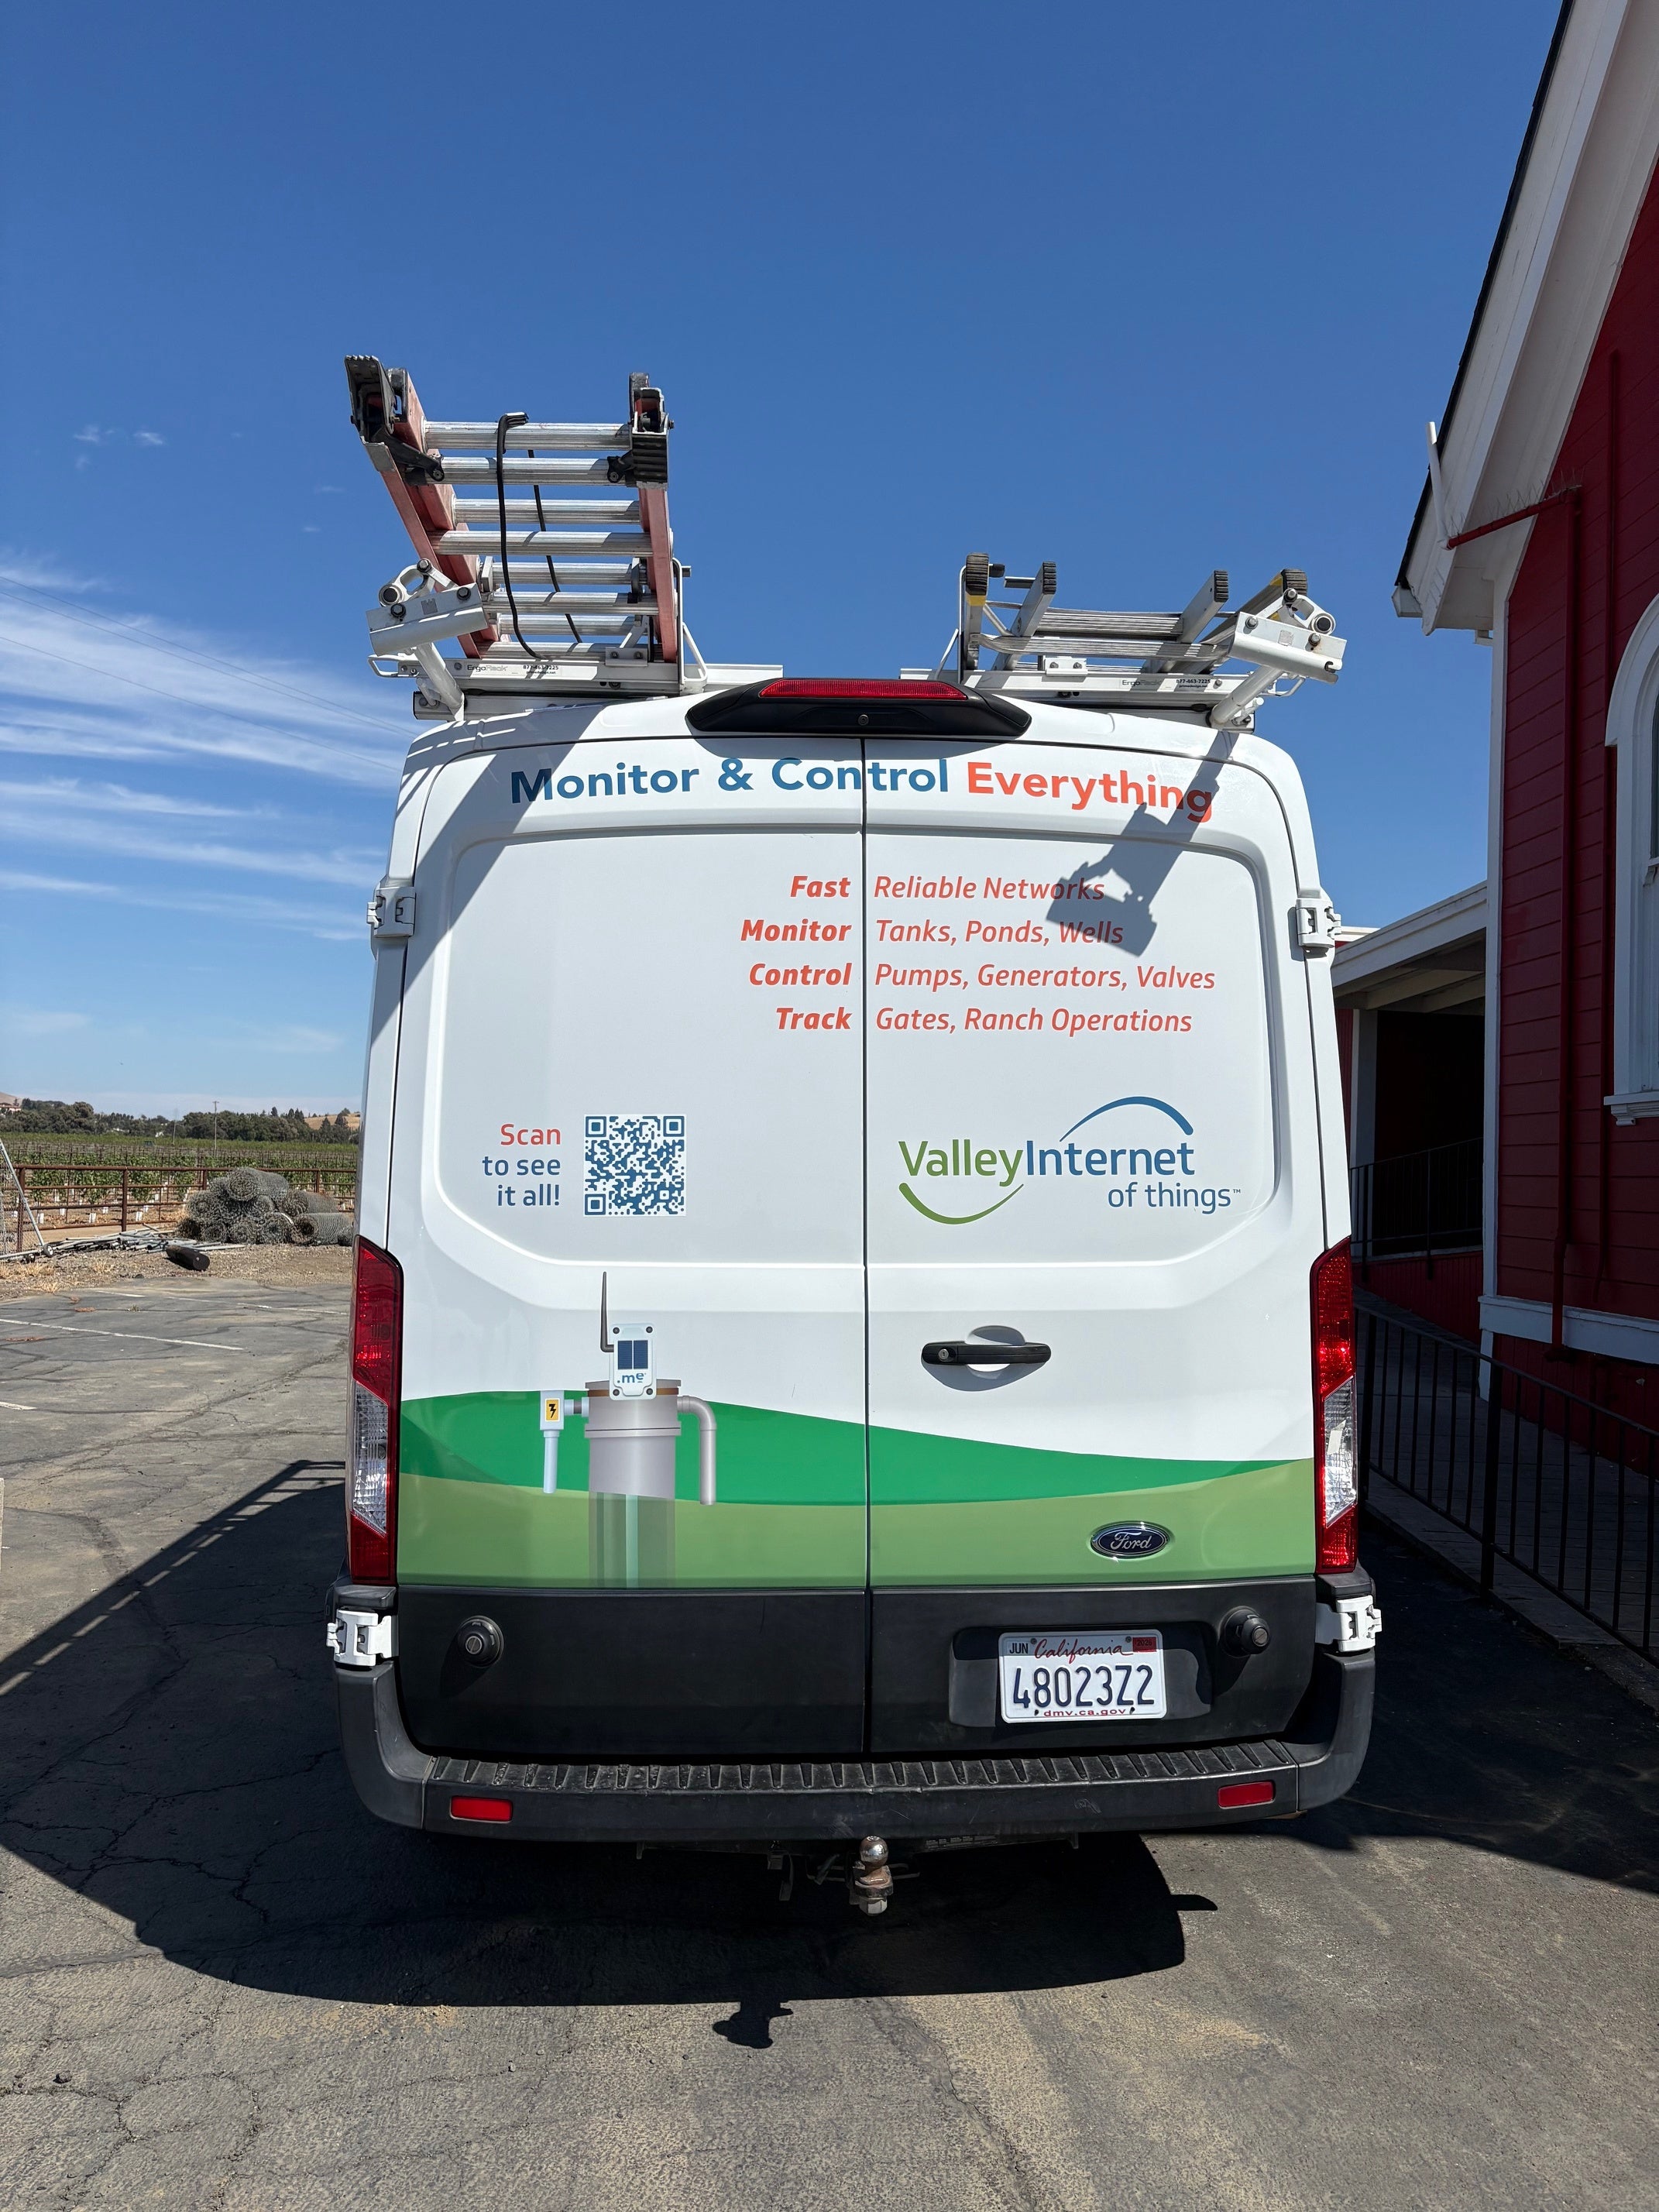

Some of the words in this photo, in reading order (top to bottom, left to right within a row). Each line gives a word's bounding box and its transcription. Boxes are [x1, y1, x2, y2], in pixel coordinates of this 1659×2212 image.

[511, 762, 699, 804] Monitor
[718, 757, 754, 791] &
[771, 757, 949, 792] Control
[967, 762, 1213, 823] Everything
[790, 875, 851, 898] Fast
[874, 876, 977, 899] Reliable
[984, 877, 1105, 901] Networks
[740, 919, 852, 942] Monitor
[876, 920, 957, 945] Tanks,
[965, 920, 1050, 946] Ponds,
[1059, 922, 1124, 944] Wells
[749, 963, 853, 986] Control
[874, 963, 969, 992] Pumps,
[977, 964, 1128, 991] Generators,
[1137, 966, 1216, 989] Valves
[775, 1007, 852, 1030] Track
[876, 1008, 957, 1033] Gates,
[964, 1008, 1043, 1031] Ranch
[1051, 1008, 1192, 1036] Operations
[500, 1123, 561, 1146] Scan
[482, 1156, 509, 1176] to
[517, 1159, 561, 1176] see
[498, 1184, 516, 1207] it
[523, 1183, 560, 1206] all!
[1108, 1182, 1137, 1207] of
[1110, 1531, 1152, 1550] Ford
[1009, 1642, 1029, 1654] JUN
[1034, 1639, 1134, 1664] California
[1013, 1664, 1155, 1709] 48023Z2
[1043, 1708, 1126, 1717] dmv.ca.gov
